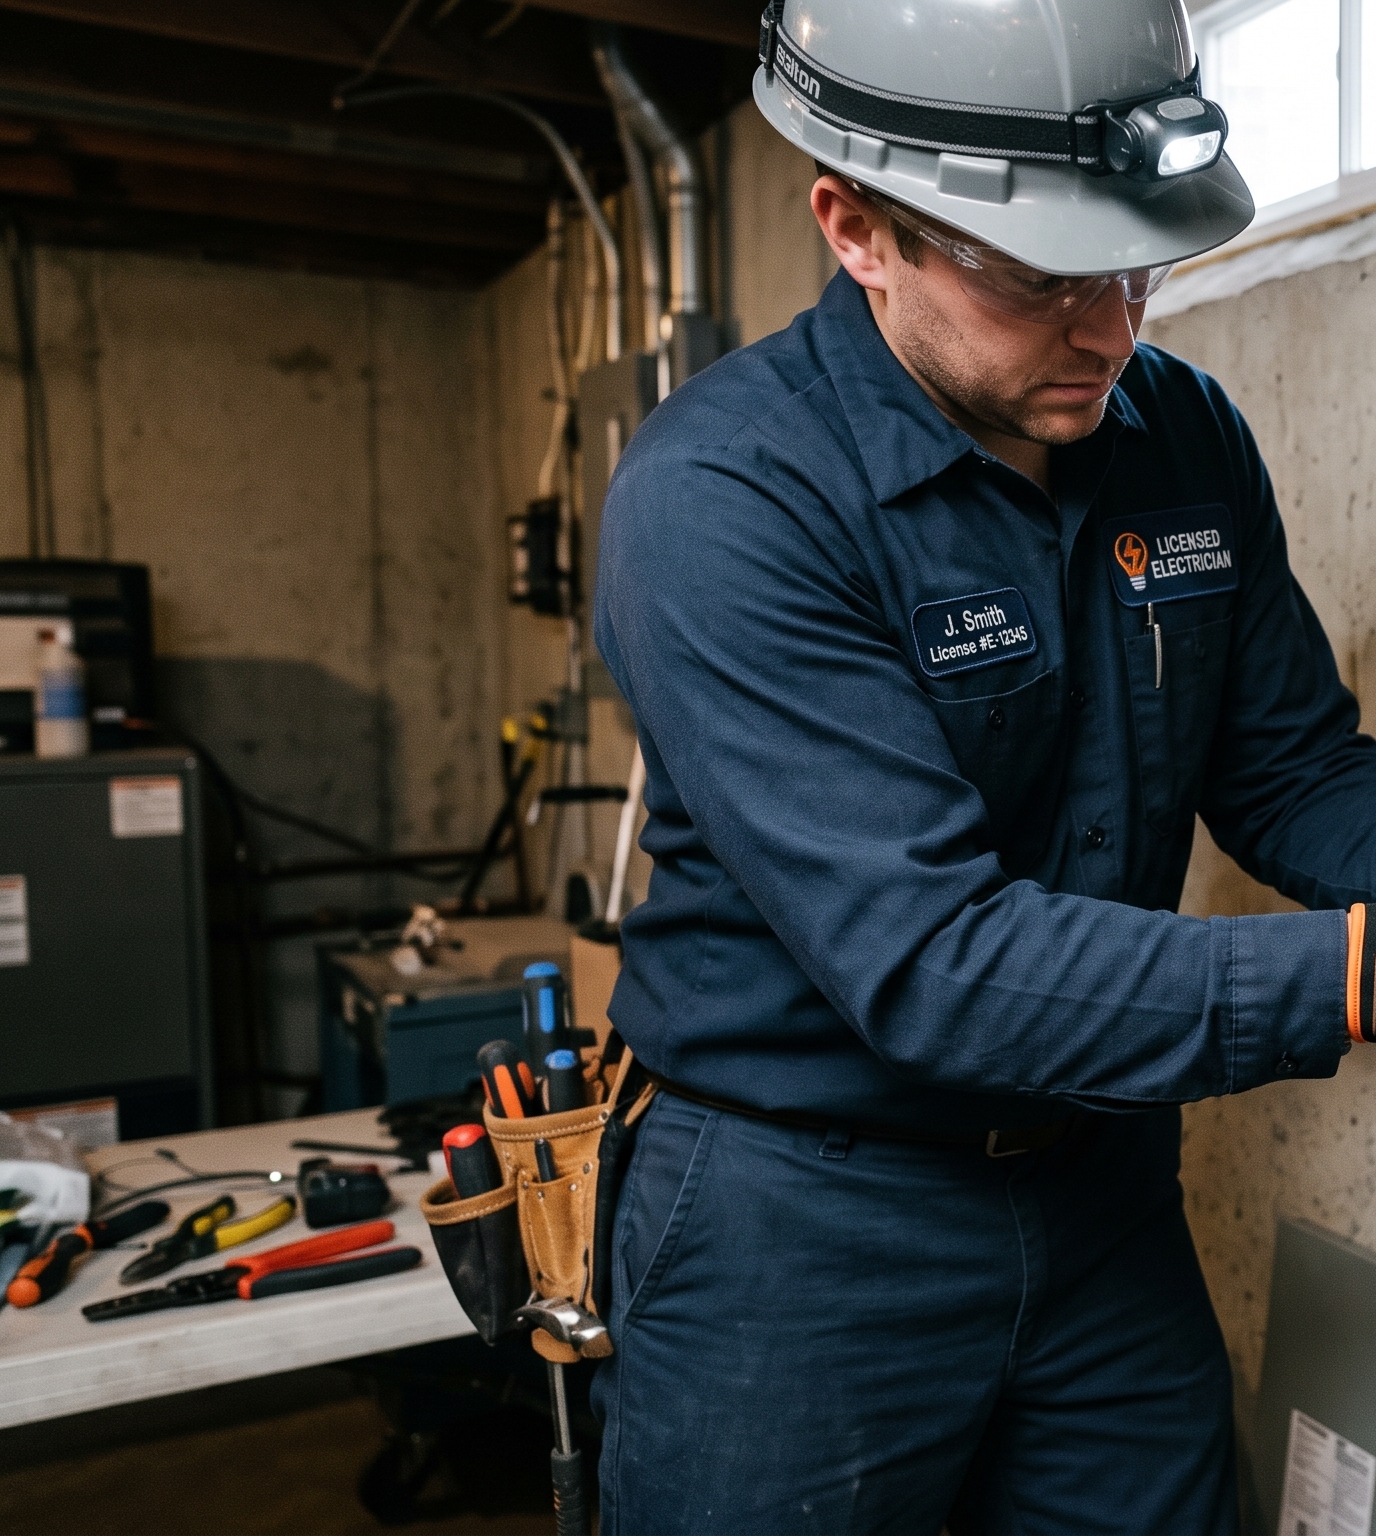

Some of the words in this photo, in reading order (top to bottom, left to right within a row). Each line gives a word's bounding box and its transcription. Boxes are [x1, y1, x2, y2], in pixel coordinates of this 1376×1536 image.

[1156, 529, 1221, 555] LICENSED
[1151, 549, 1232, 579] ELECTRICIAN
[944, 614, 959, 637] J.
[962, 604, 1007, 632] Smith
[930, 641, 978, 663] License
[979, 625, 1028, 651] #E-12345
